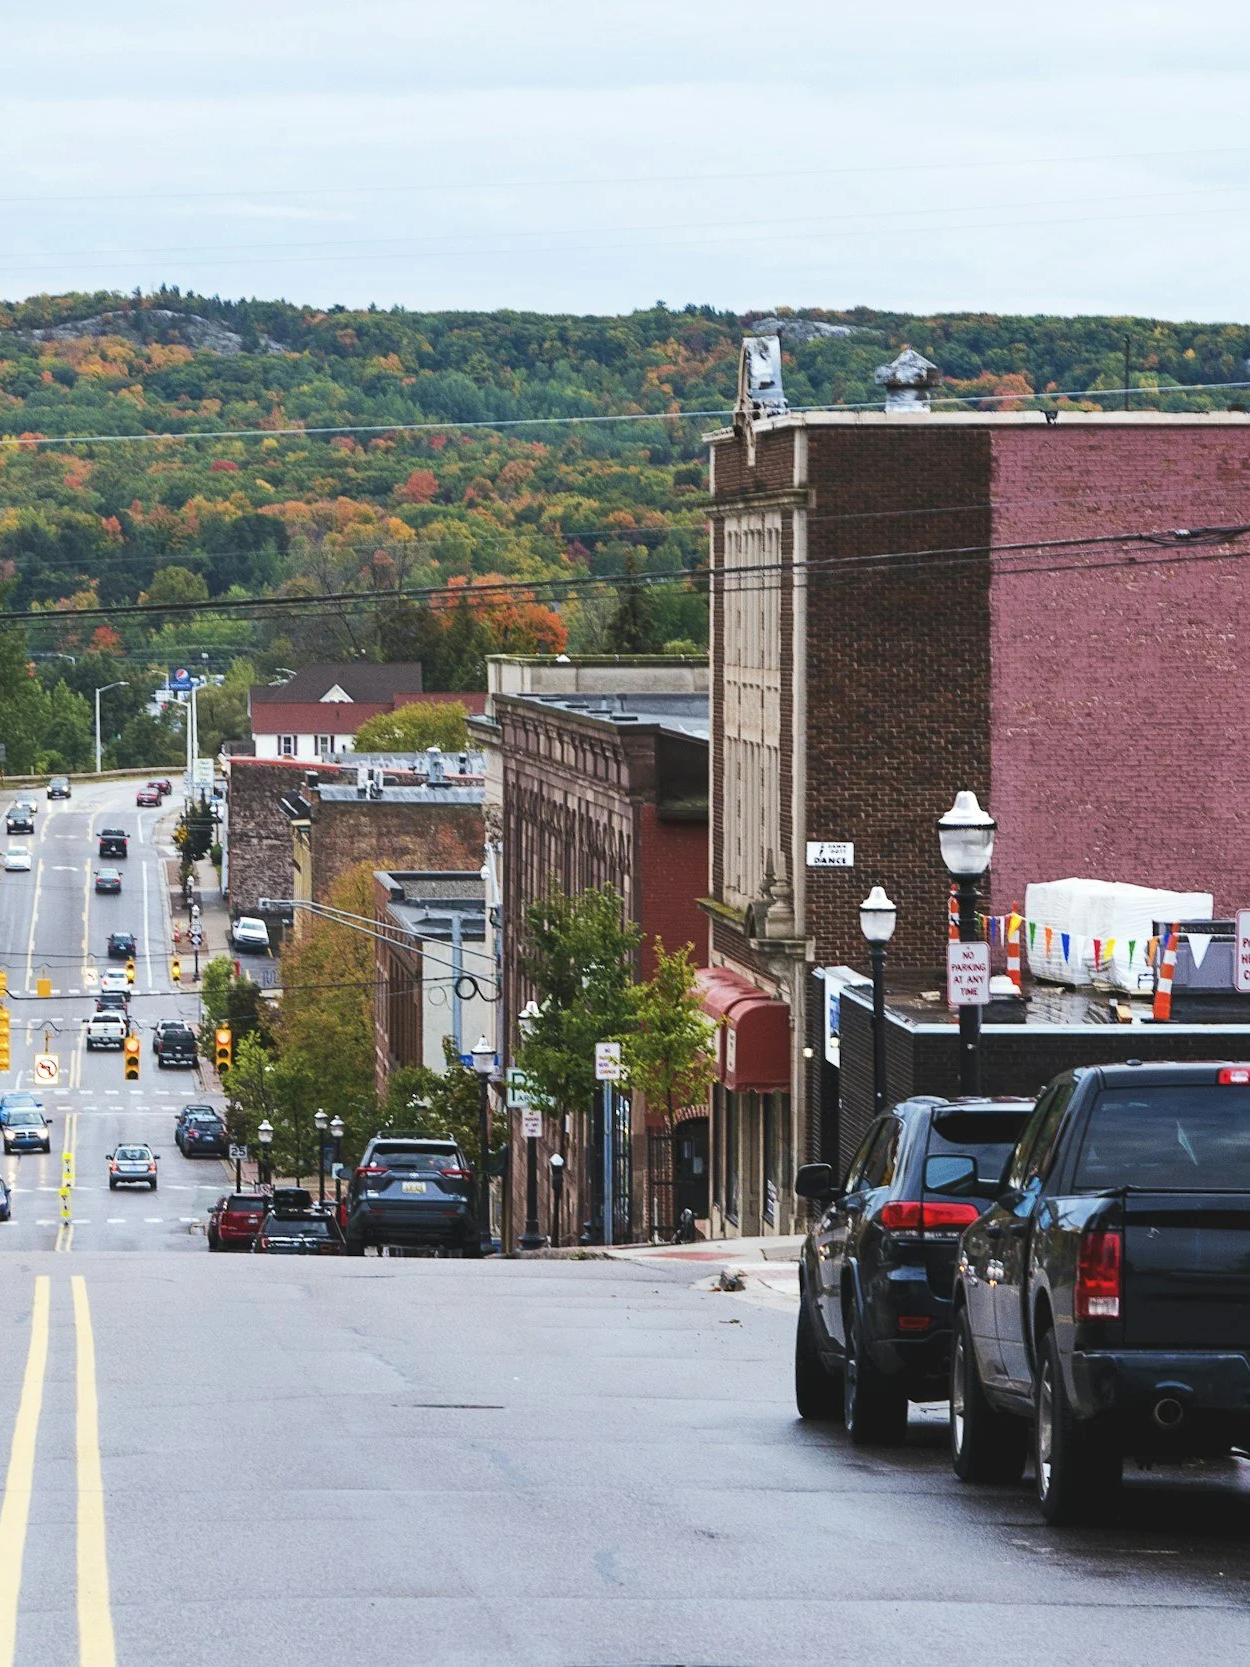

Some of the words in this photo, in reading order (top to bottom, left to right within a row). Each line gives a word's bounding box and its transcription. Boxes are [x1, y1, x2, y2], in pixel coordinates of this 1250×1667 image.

[962, 951, 974, 959] NO
[951, 963, 986, 971] PARKING
[954, 975, 962, 984] AT
[967, 975, 983, 984] ANY
[961, 987, 978, 996] TIME
[231, 1147, 246, 1156] 25
